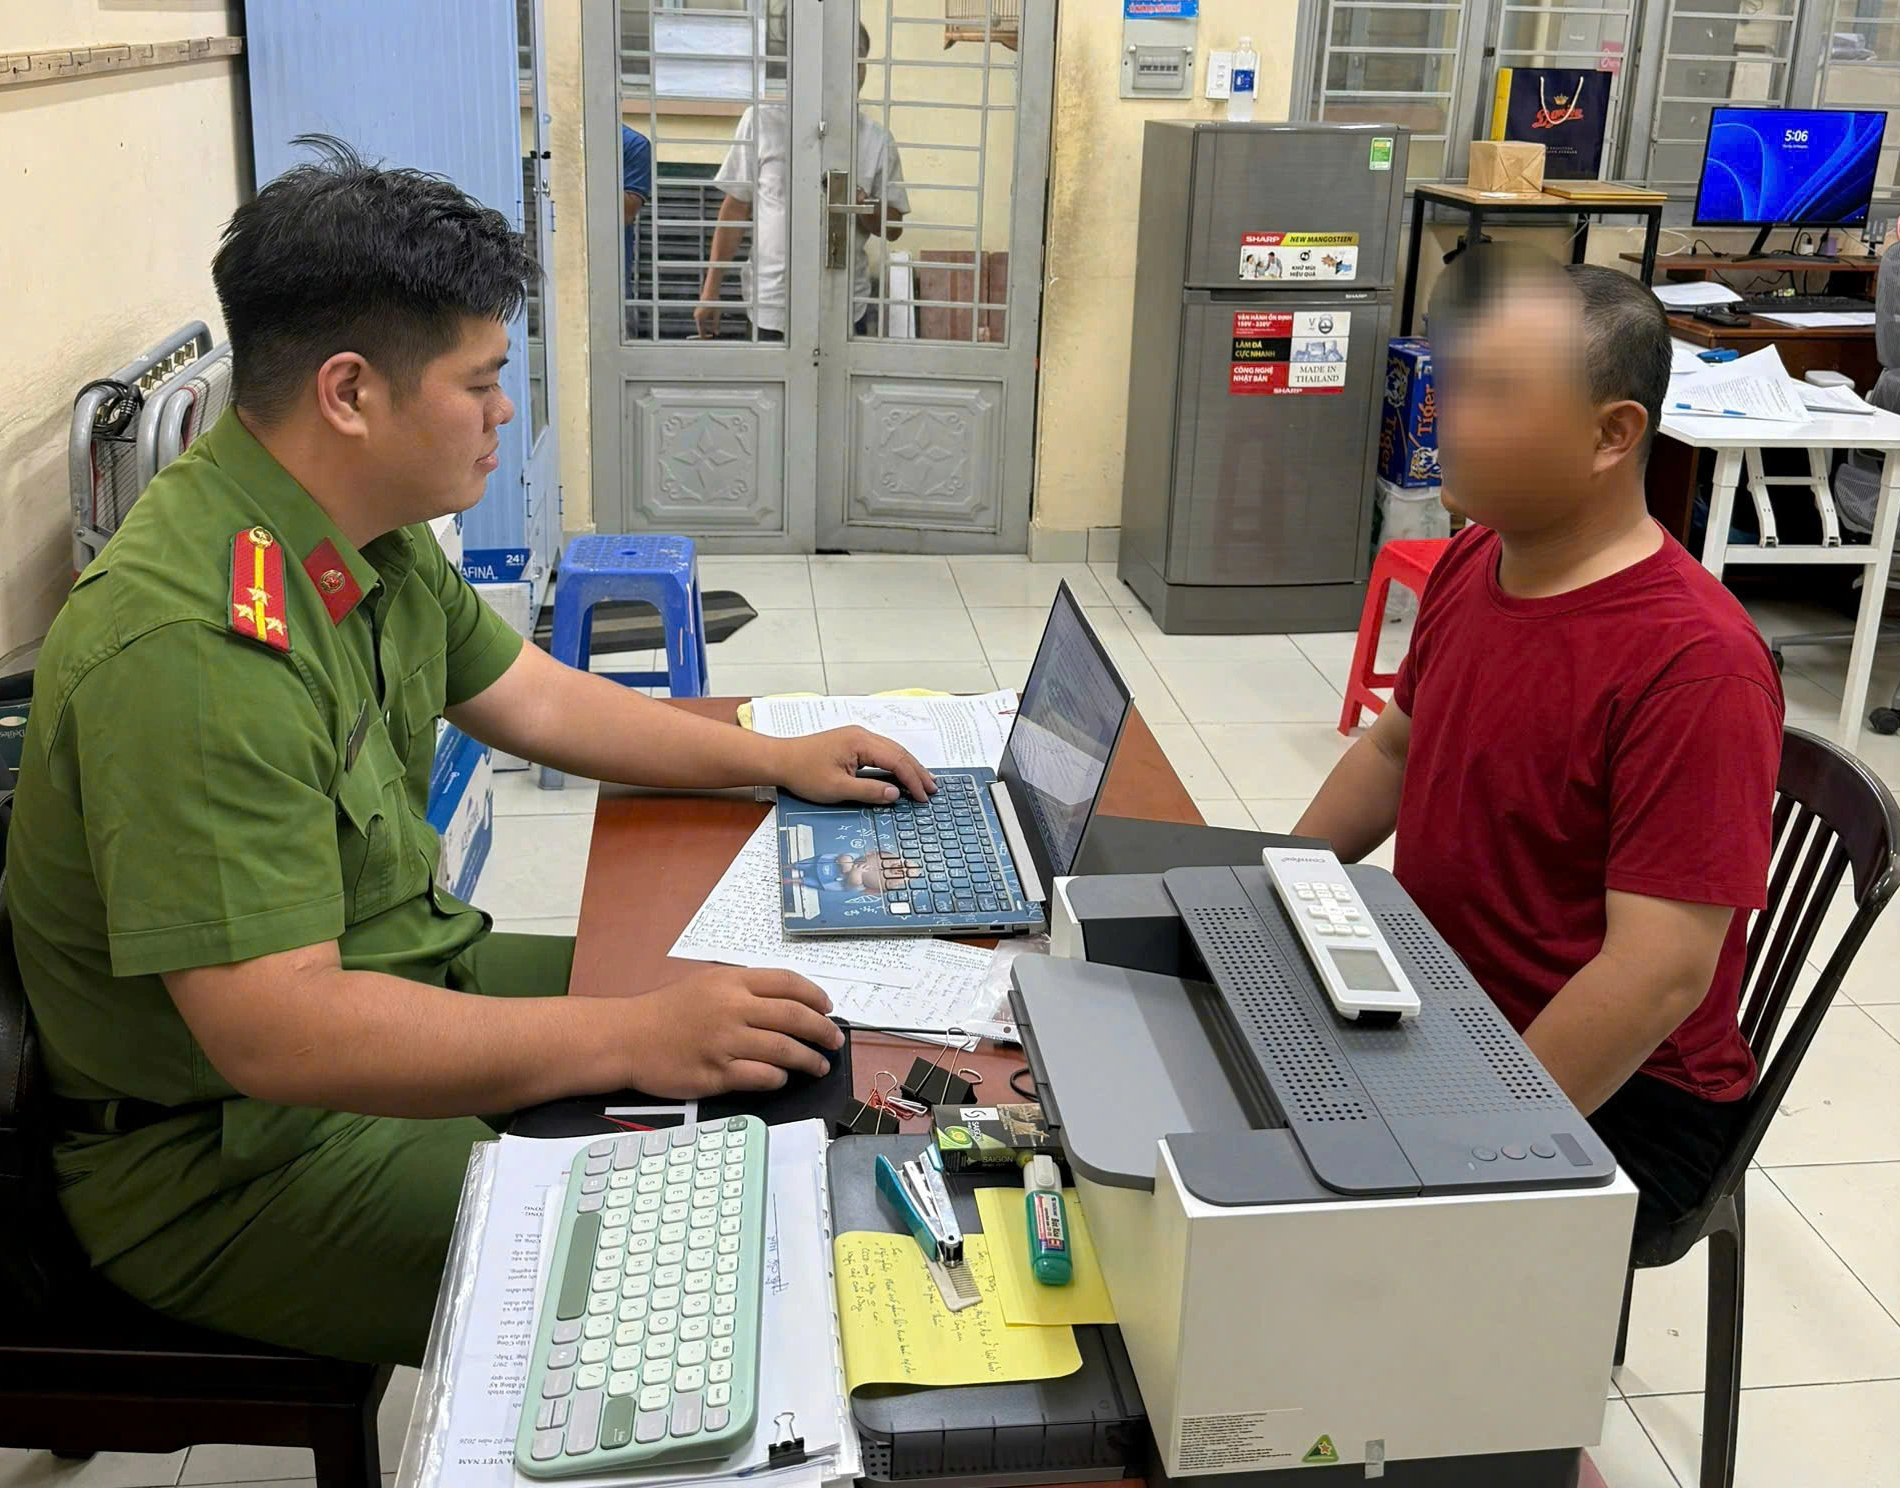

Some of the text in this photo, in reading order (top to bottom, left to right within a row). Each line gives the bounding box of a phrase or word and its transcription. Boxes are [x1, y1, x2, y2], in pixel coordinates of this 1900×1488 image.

[1784, 129, 1809, 142] 5:06
[1235, 340, 1263, 348] LÀM ĐÁ
[1235, 350, 1250, 359] CỰC
[1233, 366, 1273, 375] CÔNG NGHỆ
[1299, 366, 1325, 374] MADE
[1233, 374, 1268, 384] NHẬT BẢN
[1295, 375, 1339, 383] THAILAND
[1417, 384, 1438, 437] Tiger
[1379, 416, 1397, 476] Tiger
[505, 554, 520, 563] 24
[481, 1456, 504, 1464] VIỆT
